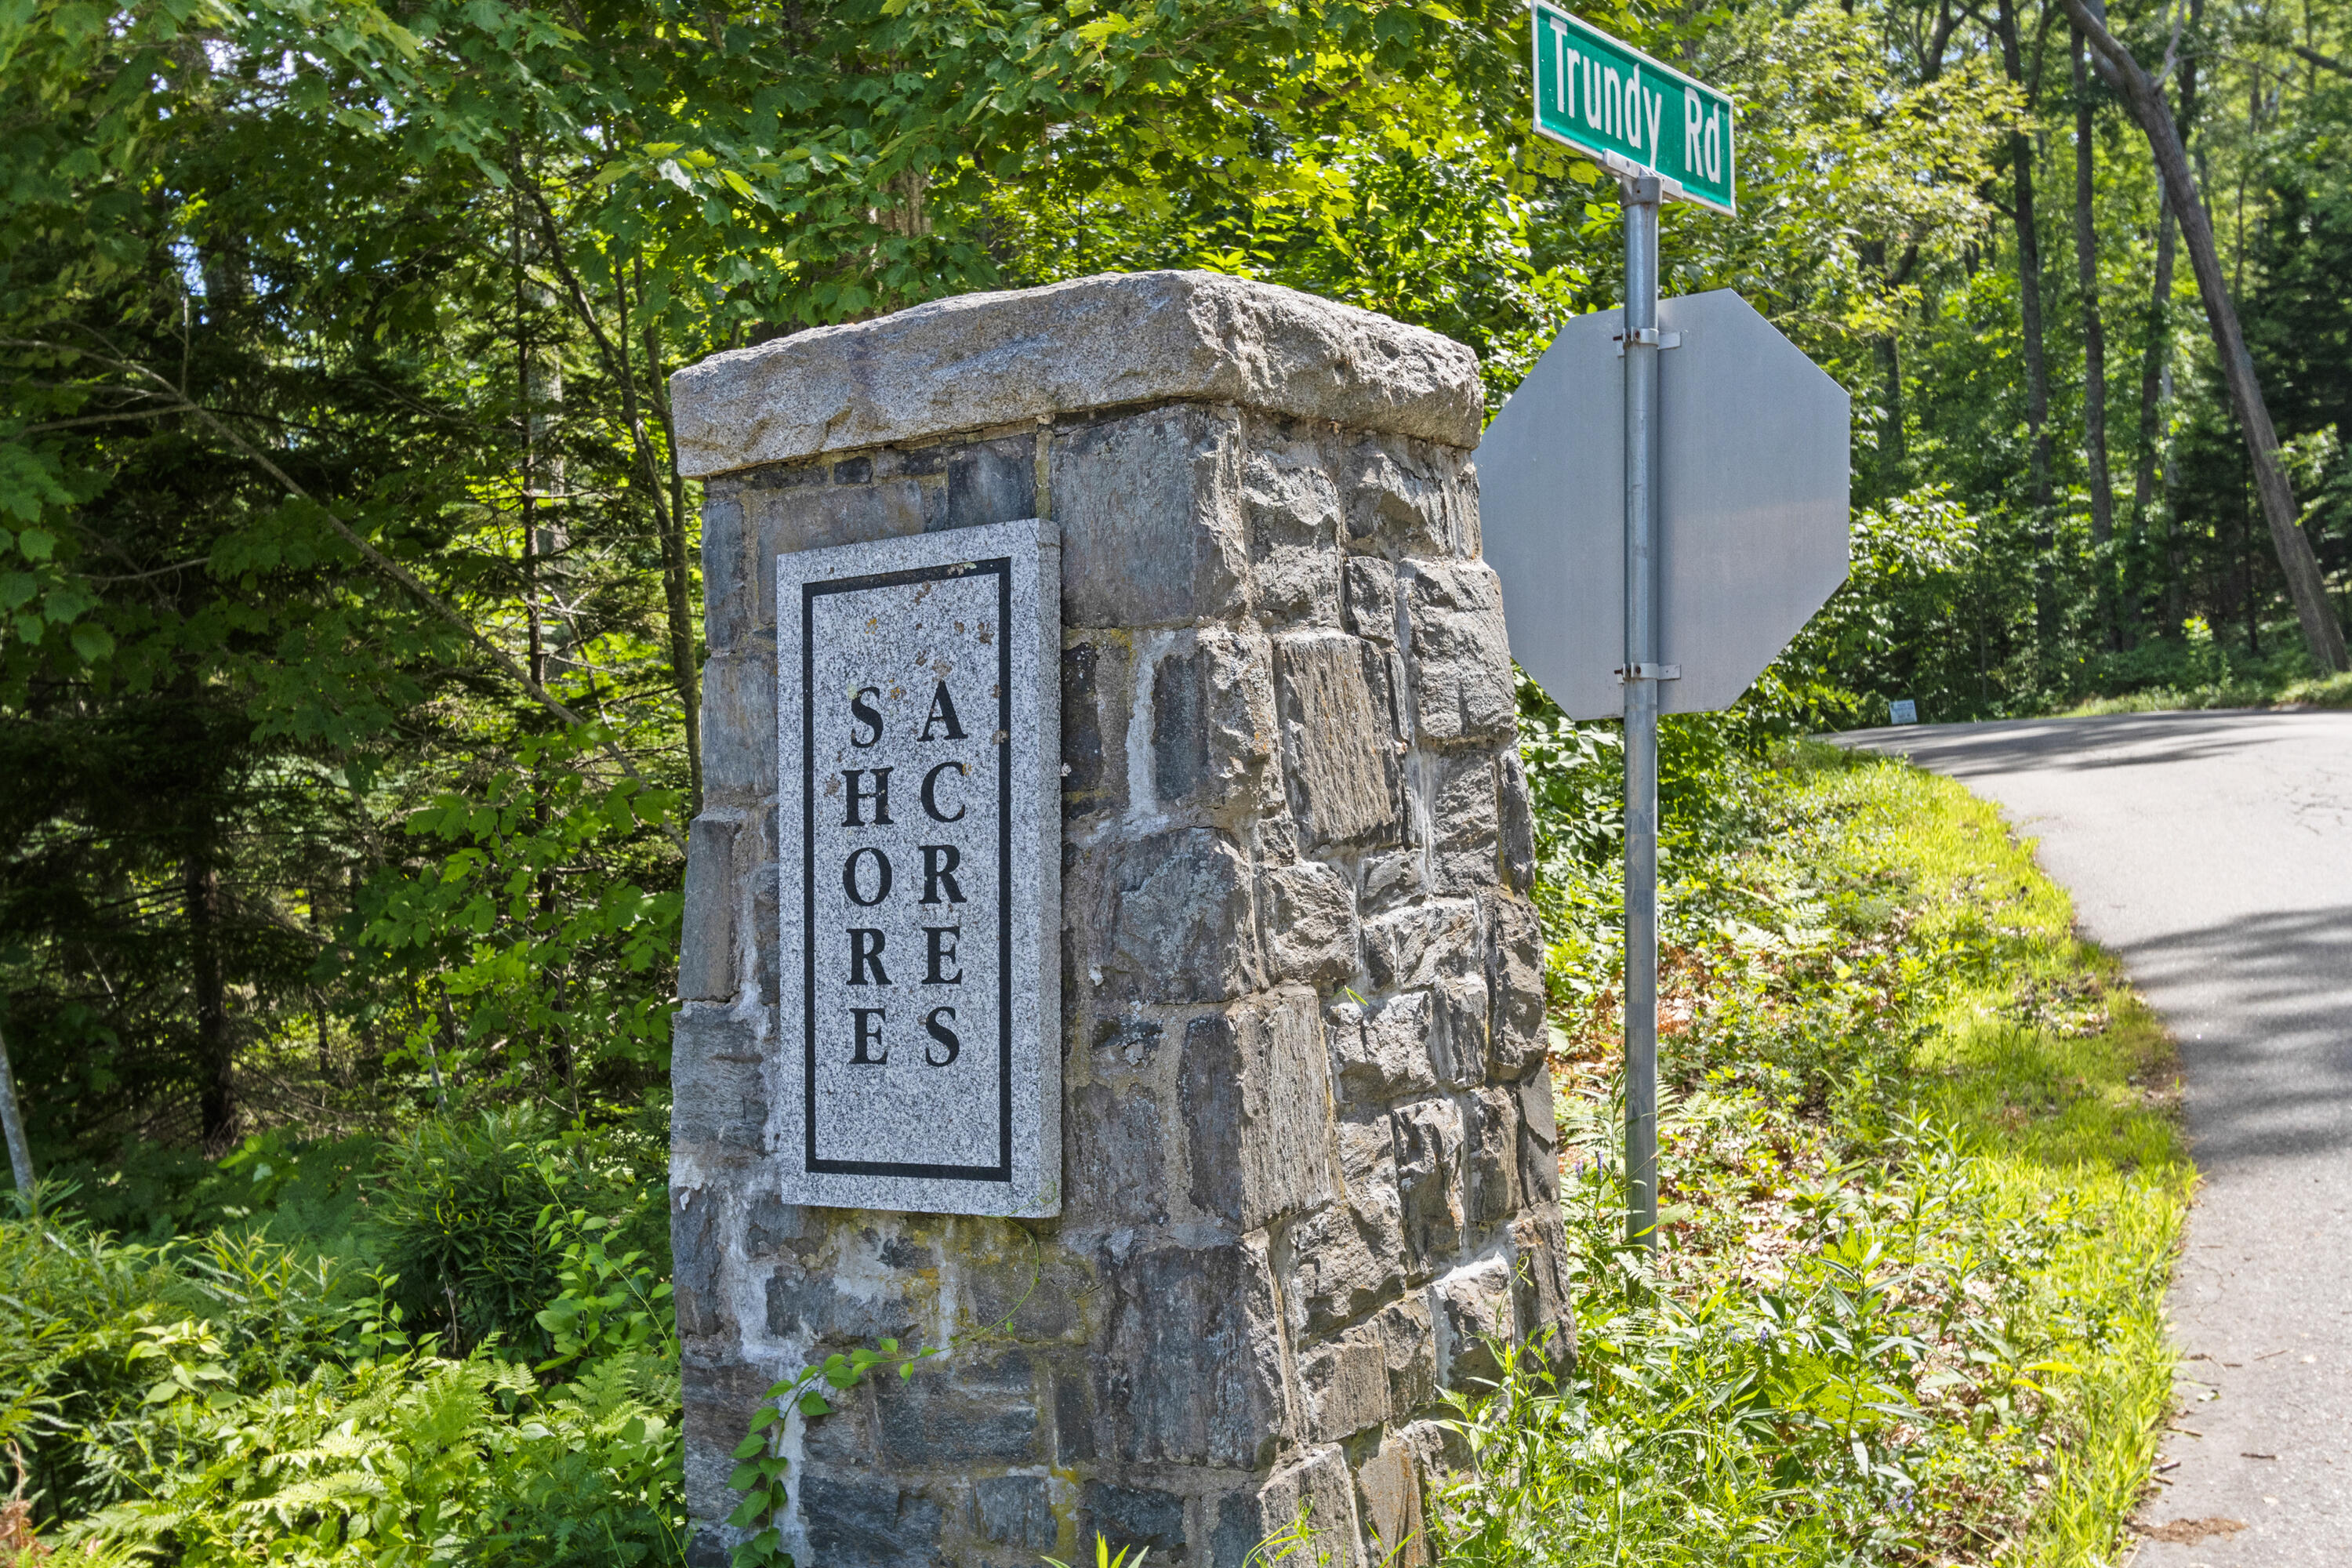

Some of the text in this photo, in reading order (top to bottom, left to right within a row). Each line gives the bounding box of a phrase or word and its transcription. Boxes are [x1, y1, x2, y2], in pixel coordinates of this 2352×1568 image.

[1550, 16, 1721, 184] Trundy Rd
[841, 686, 894, 1065] SHORE
[917, 680, 968, 1068] ACRES
